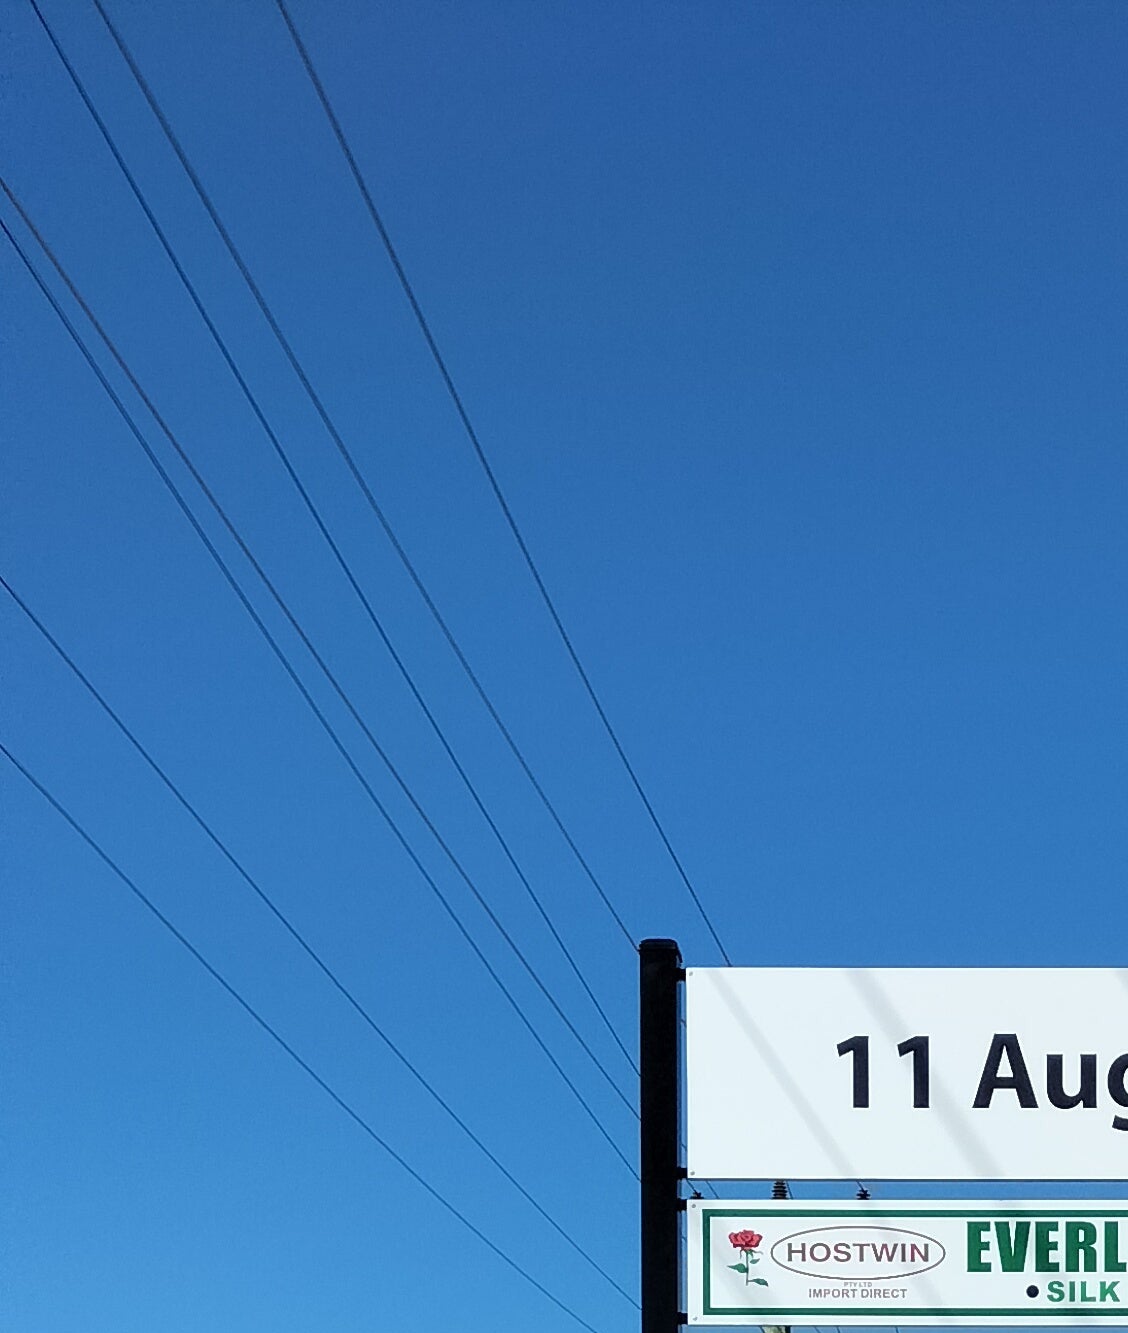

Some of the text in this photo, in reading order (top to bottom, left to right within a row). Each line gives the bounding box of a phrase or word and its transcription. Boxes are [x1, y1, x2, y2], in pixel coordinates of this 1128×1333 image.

[836, 1035, 930, 1109] 11
[786, 1242, 930, 1263] HOSTWIN
[808, 1288, 908, 1299] IMPORT DIRECT
[1046, 1280, 1120, 1303] SILK
